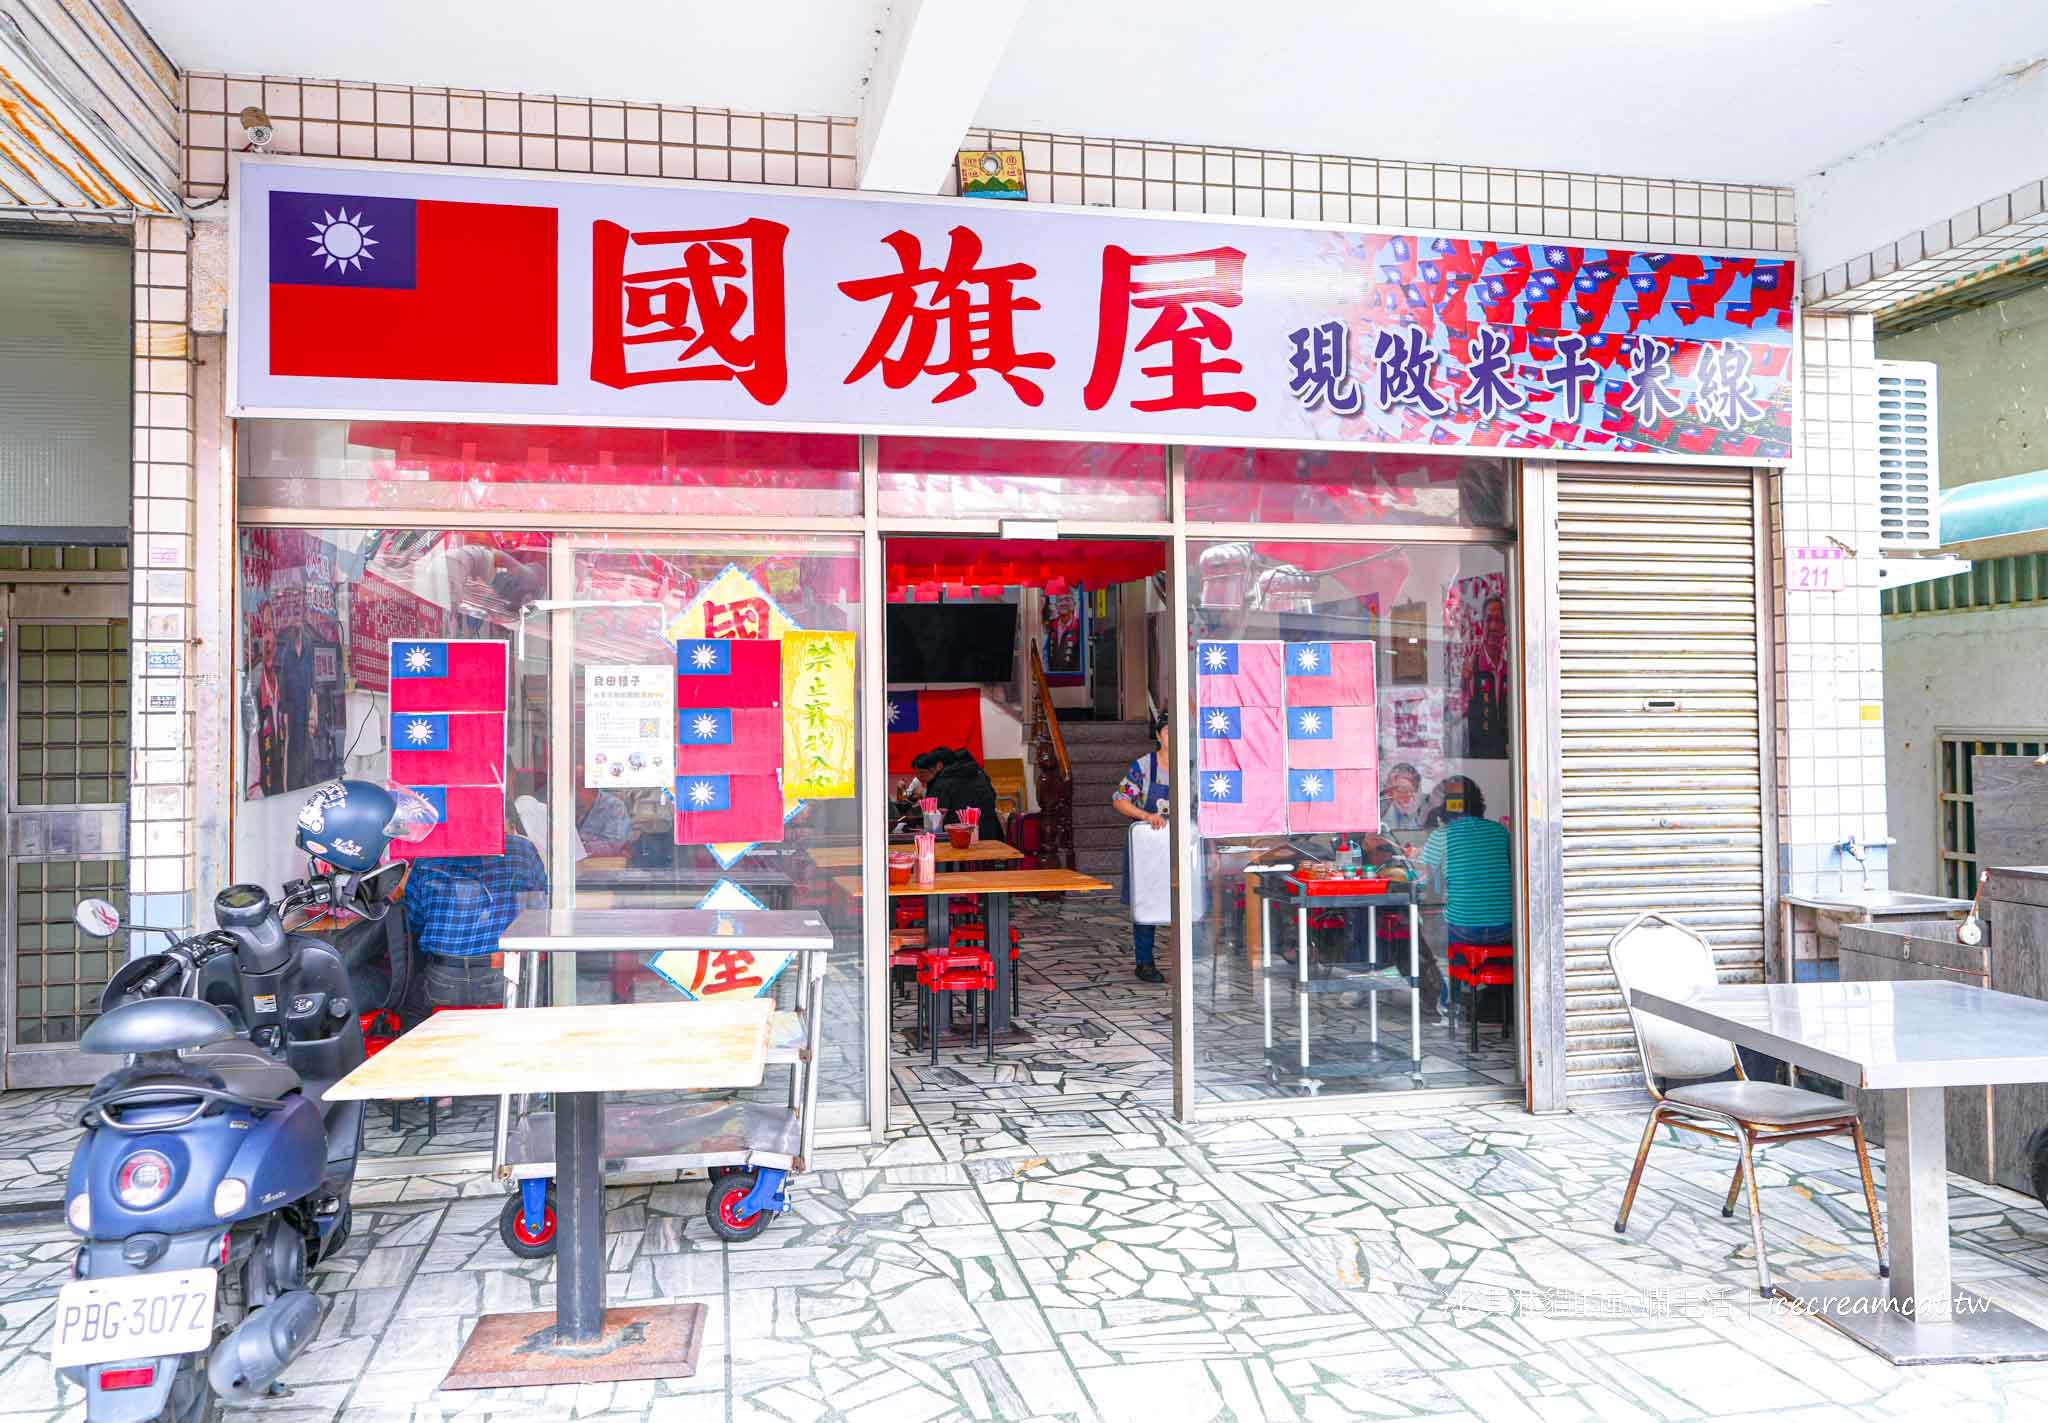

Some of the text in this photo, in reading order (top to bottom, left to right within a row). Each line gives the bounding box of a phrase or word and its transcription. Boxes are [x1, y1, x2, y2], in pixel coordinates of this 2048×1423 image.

[591, 217, 1257, 412] 國旗屋
[1288, 321, 1764, 430] 現做米干米線
[1799, 565, 1829, 587] 211
